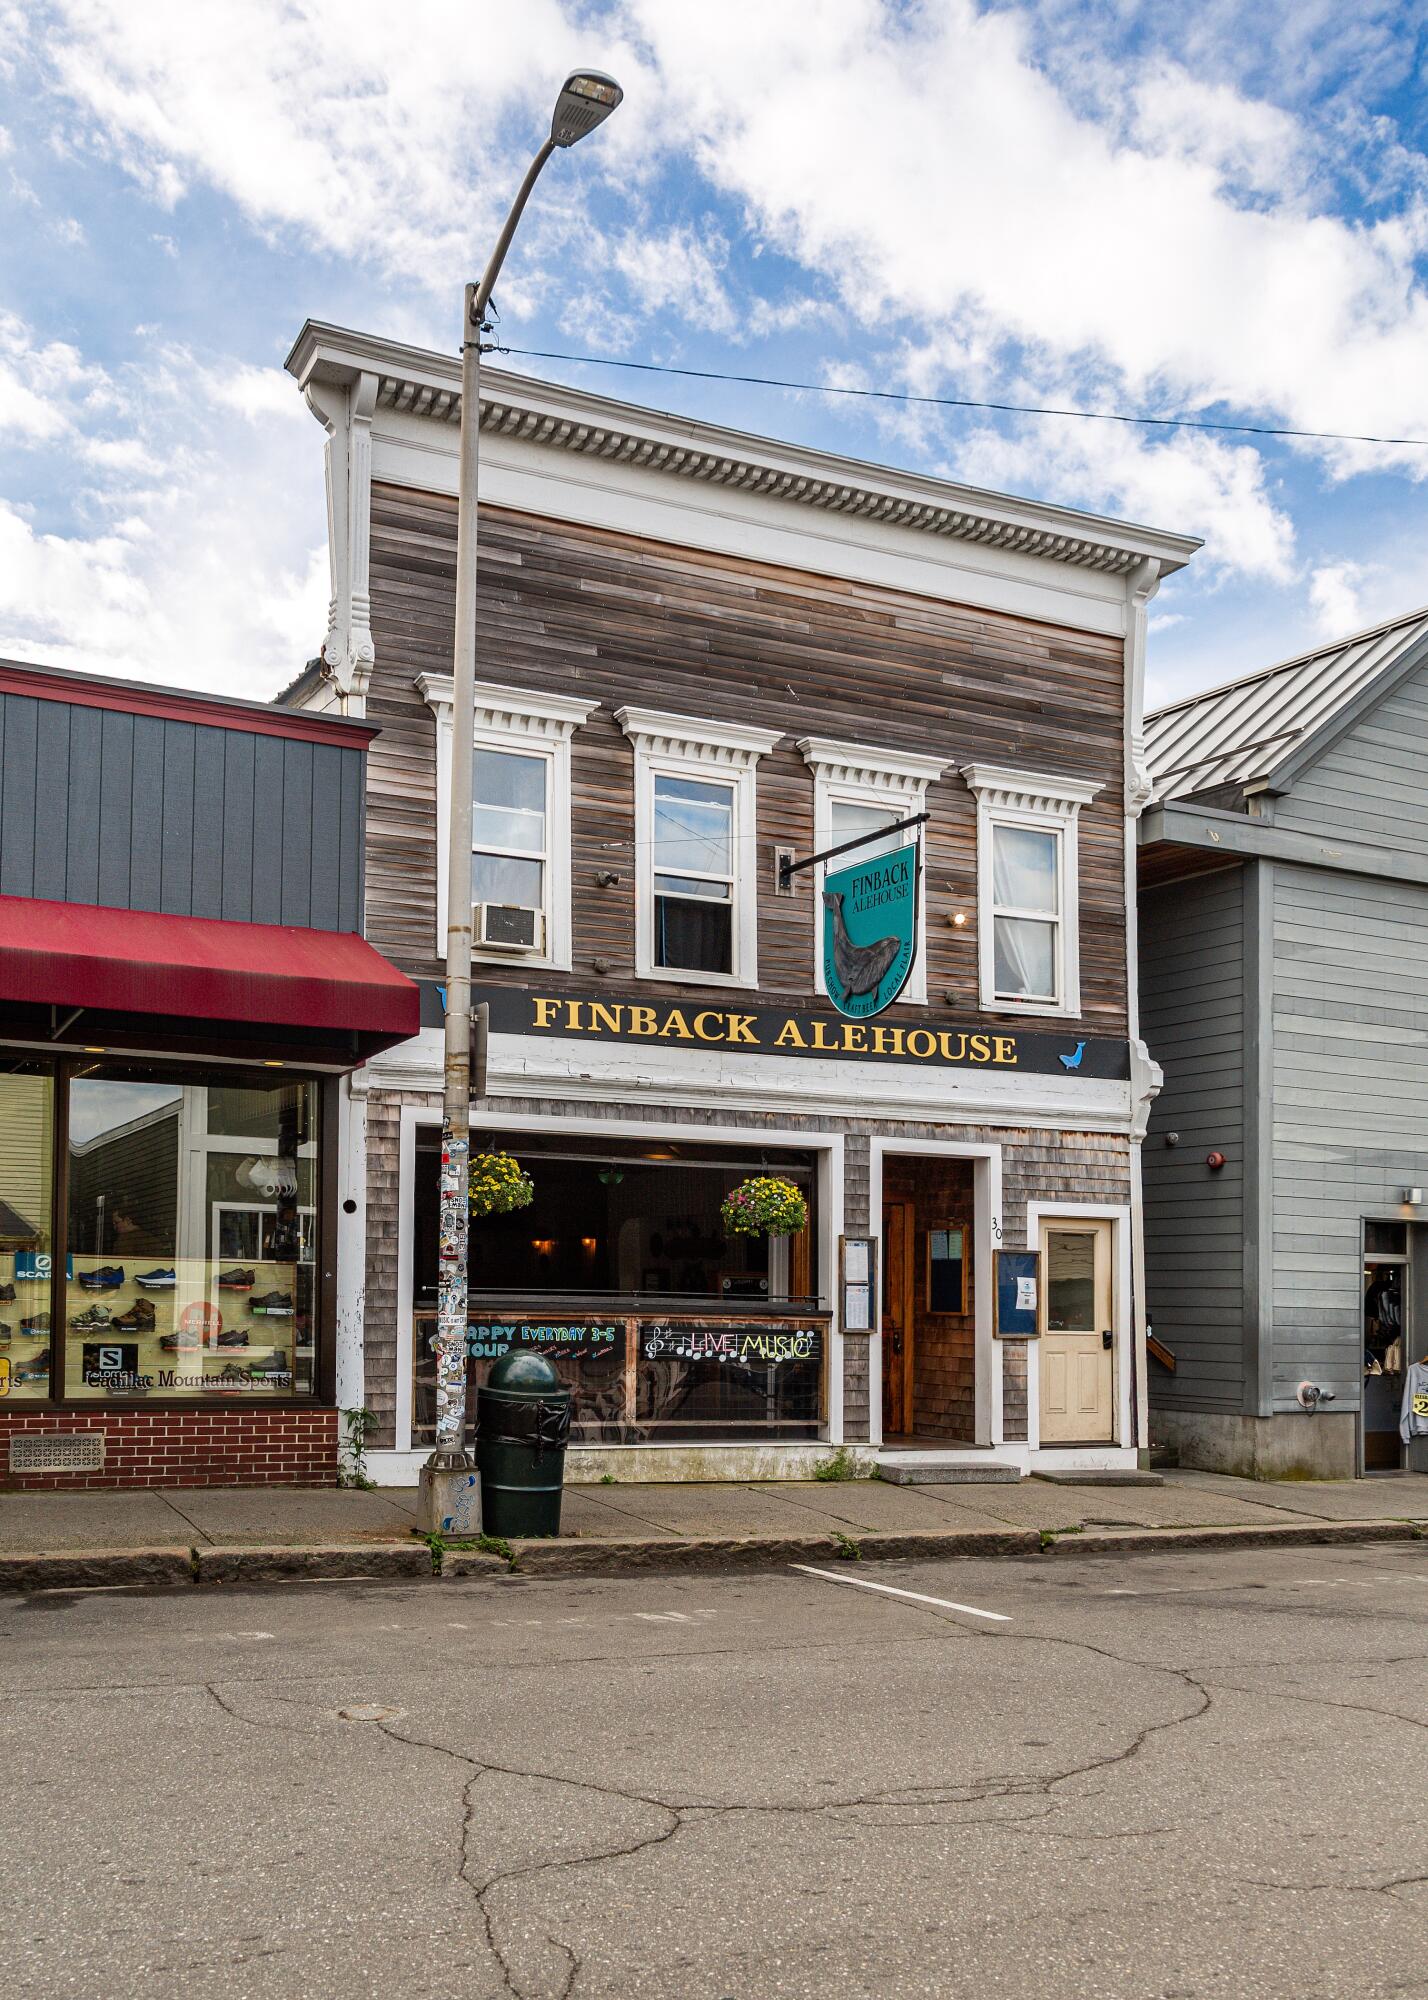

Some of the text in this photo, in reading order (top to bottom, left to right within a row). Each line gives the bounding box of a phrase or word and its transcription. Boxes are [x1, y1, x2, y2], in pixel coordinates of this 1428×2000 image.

[852, 861, 909, 898] FINBACK
[852, 882, 909, 914] ALEHOUSE
[883, 940, 911, 1001] LOCAL FLAIR
[843, 1001, 878, 1013] CRAFT BEER
[533, 998, 1018, 1064] FINBACK ALEHOUSE
[465, 1325, 616, 1342] APPY EVERYDAY 3-5
[691, 1332, 811, 1360] LIVE MUSIC
[465, 1342, 510, 1357] OUR
[87, 1370, 290, 1391] Cadillac Mountain Sports
